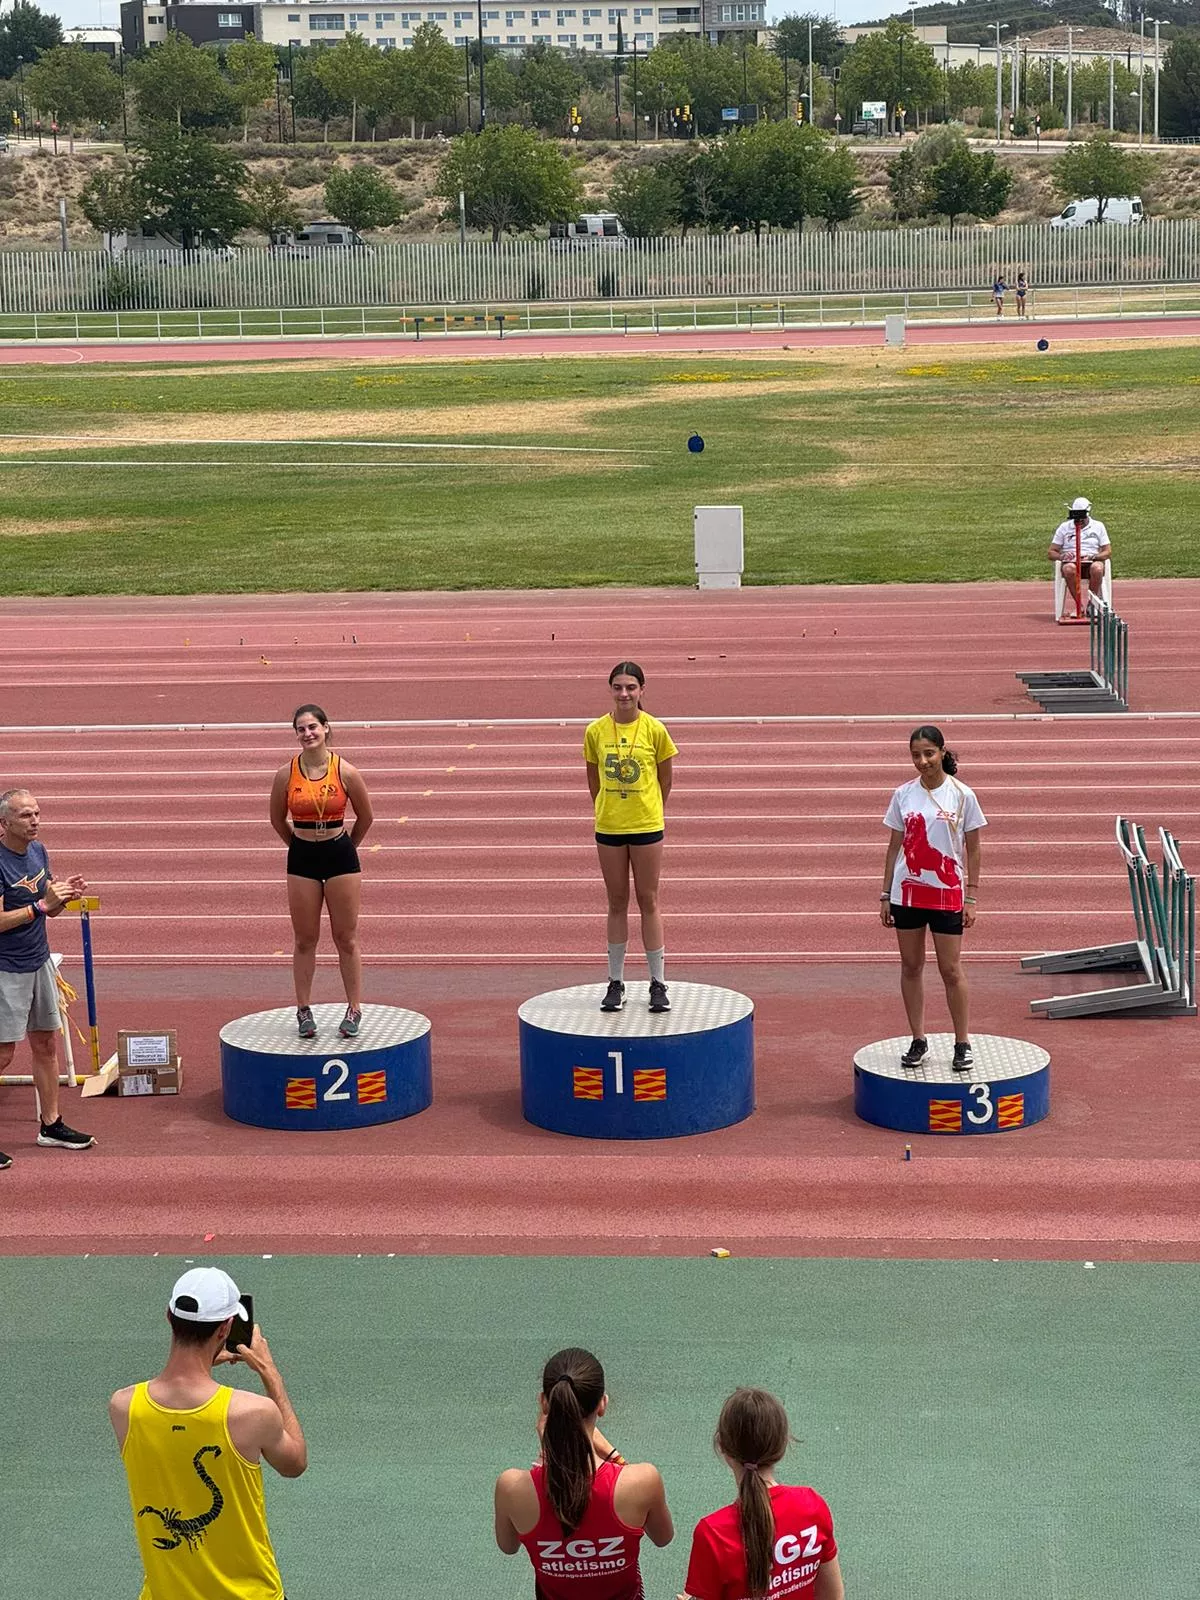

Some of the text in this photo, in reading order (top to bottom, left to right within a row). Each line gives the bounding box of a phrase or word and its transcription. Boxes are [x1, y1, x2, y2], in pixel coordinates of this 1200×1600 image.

[605, 753, 640, 783] 50
[322, 1059, 350, 1101] 2
[608, 1051, 623, 1093] 1
[967, 1083, 993, 1124] 3
[537, 1536, 625, 1558] ZGZ
[541, 1558, 626, 1571] atletismo
[769, 1525, 822, 1568] GZ
[769, 1559, 821, 1590] letismo
